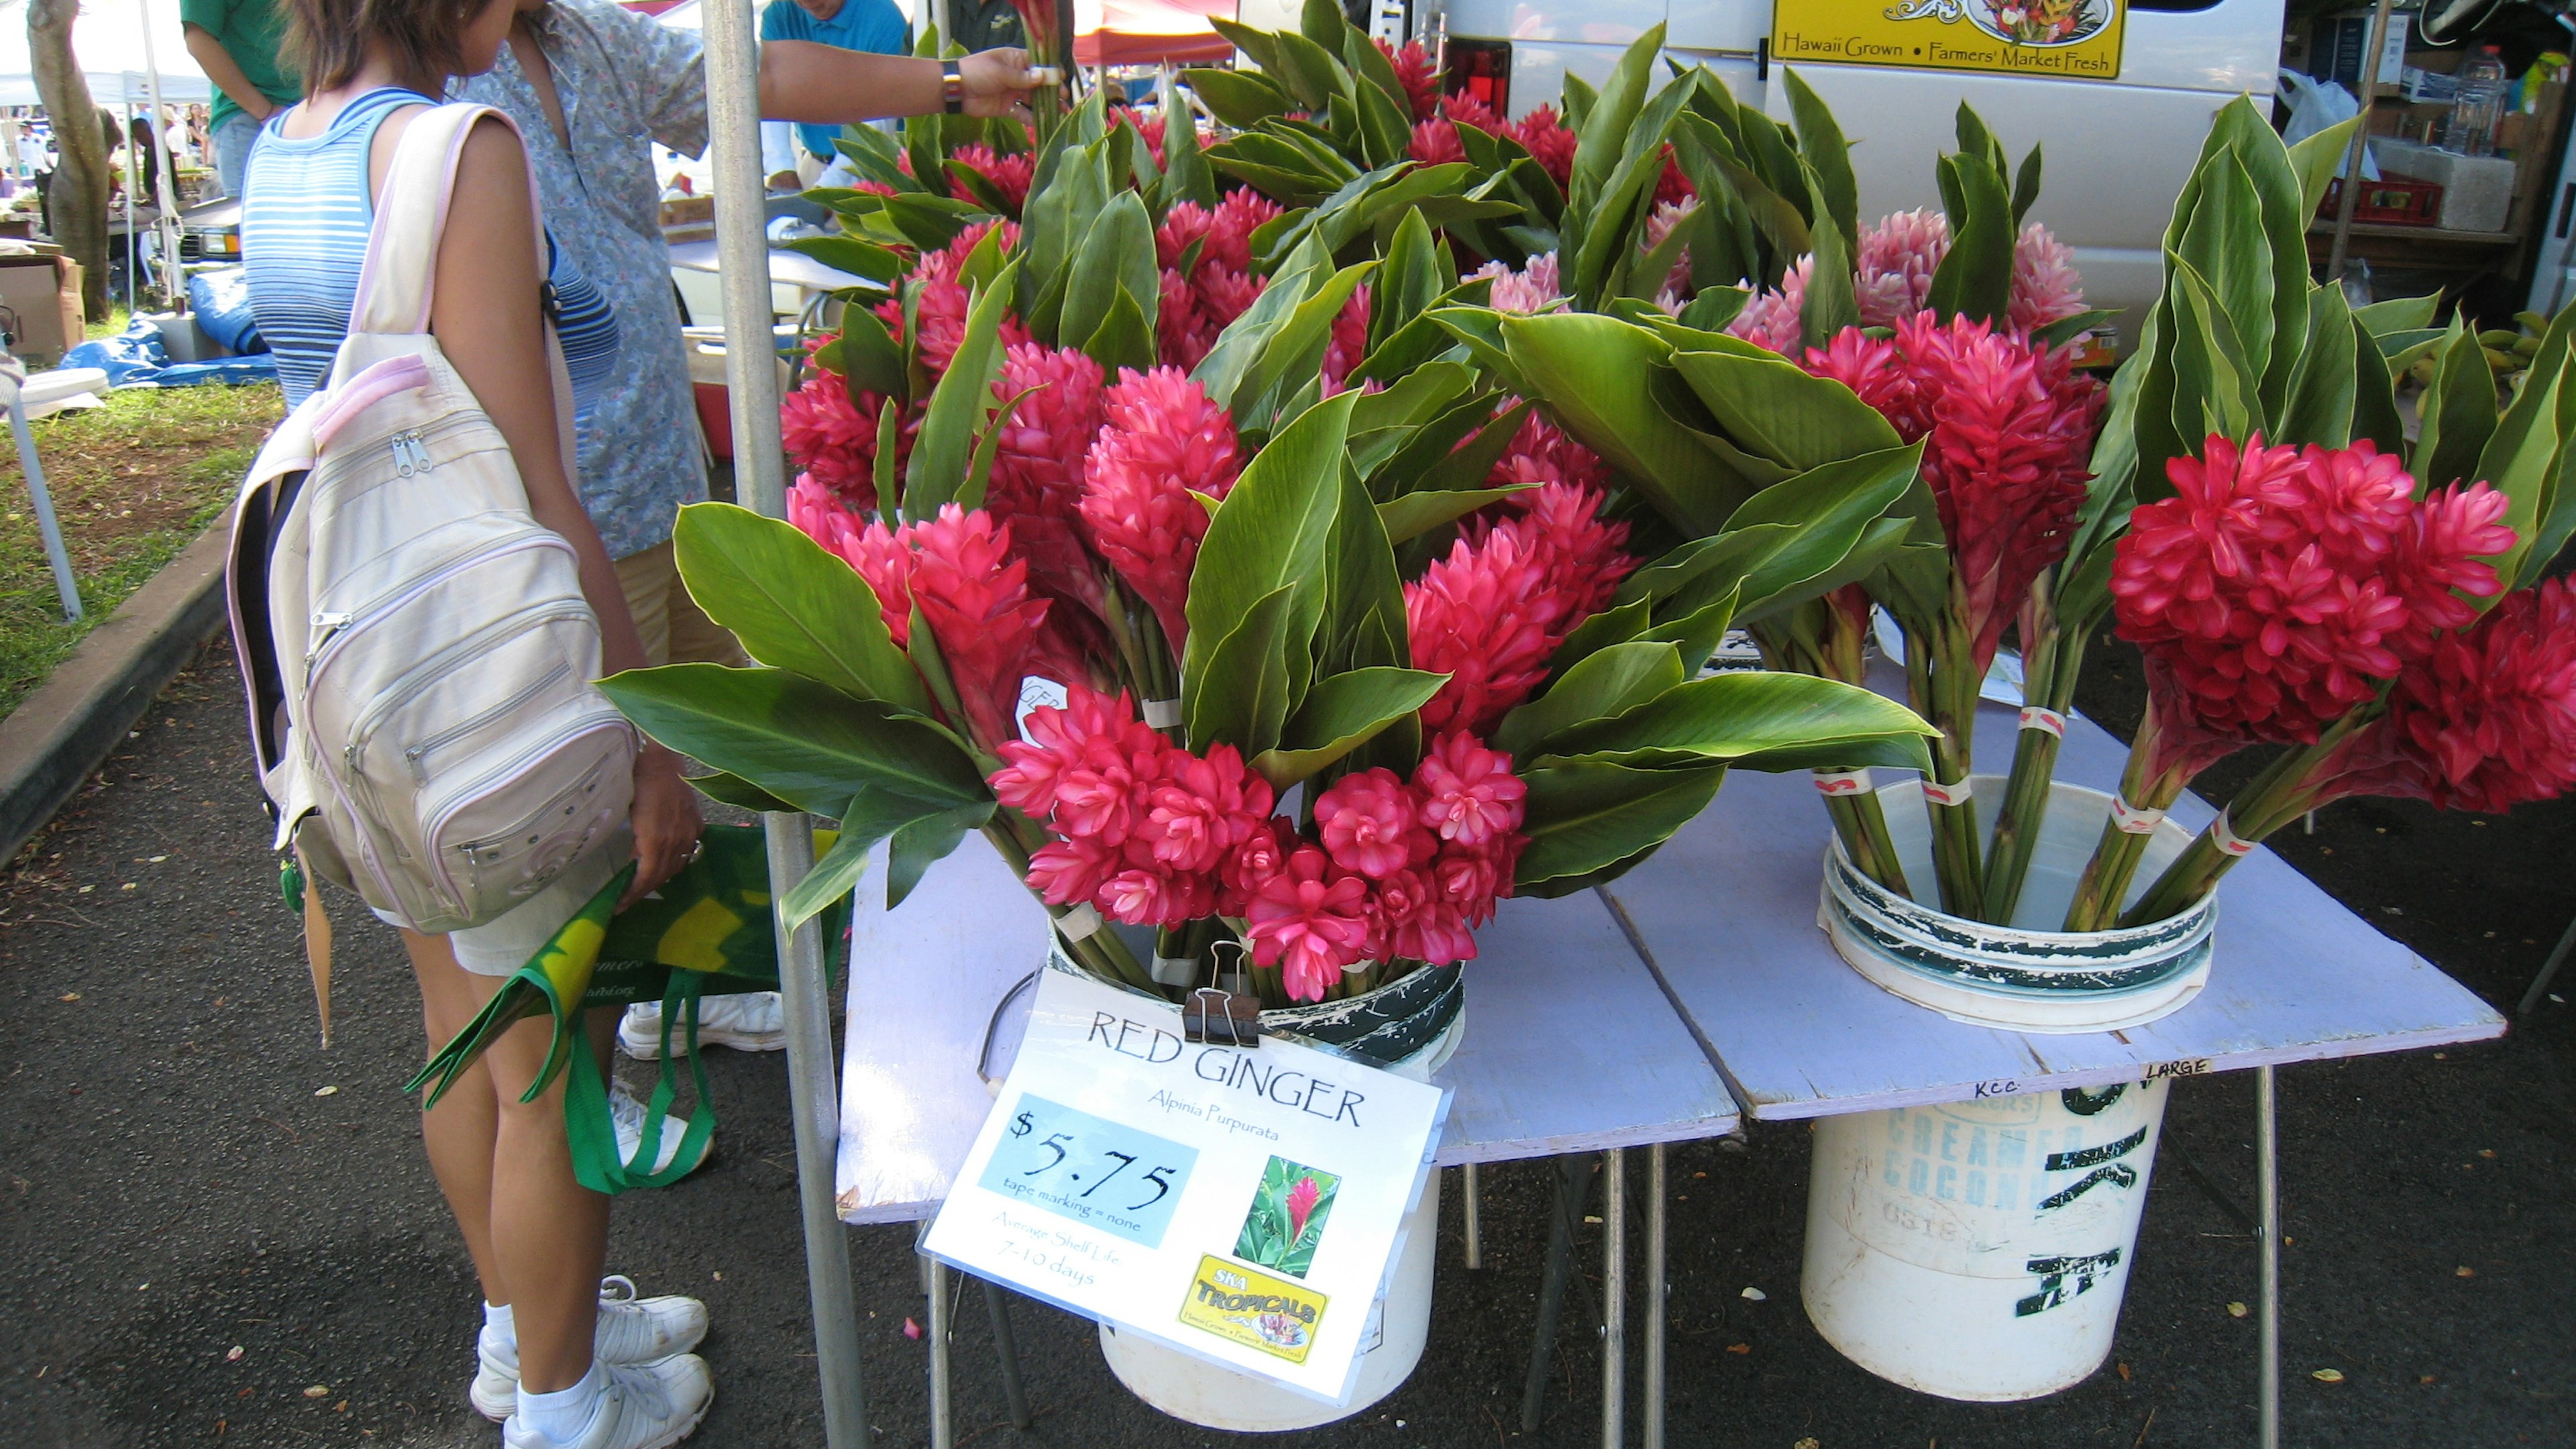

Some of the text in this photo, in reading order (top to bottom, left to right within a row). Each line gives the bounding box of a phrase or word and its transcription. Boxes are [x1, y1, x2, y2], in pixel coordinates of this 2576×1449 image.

[1782, 32, 2109, 70] Hawaii Grown Farmers' Market Fresh
[1087, 1011, 1365, 1128] RED GINGER
[2146, 1058, 2212, 1079] LARGE
[1147, 1089, 1280, 1141] Alpinia Purpurata
[1003, 1177, 1035, 1197] tape
[1038, 1191, 1091, 1218] marking
[1106, 1213, 1142, 1232] none
[991, 1211, 1049, 1241] Average
[1050, 1232, 1093, 1254] Shelf
[998, 1240, 1095, 1287] 7-10 days
[1212, 1268, 1248, 1292] SKA
[1197, 1279, 1317, 1324] TROPICALS
